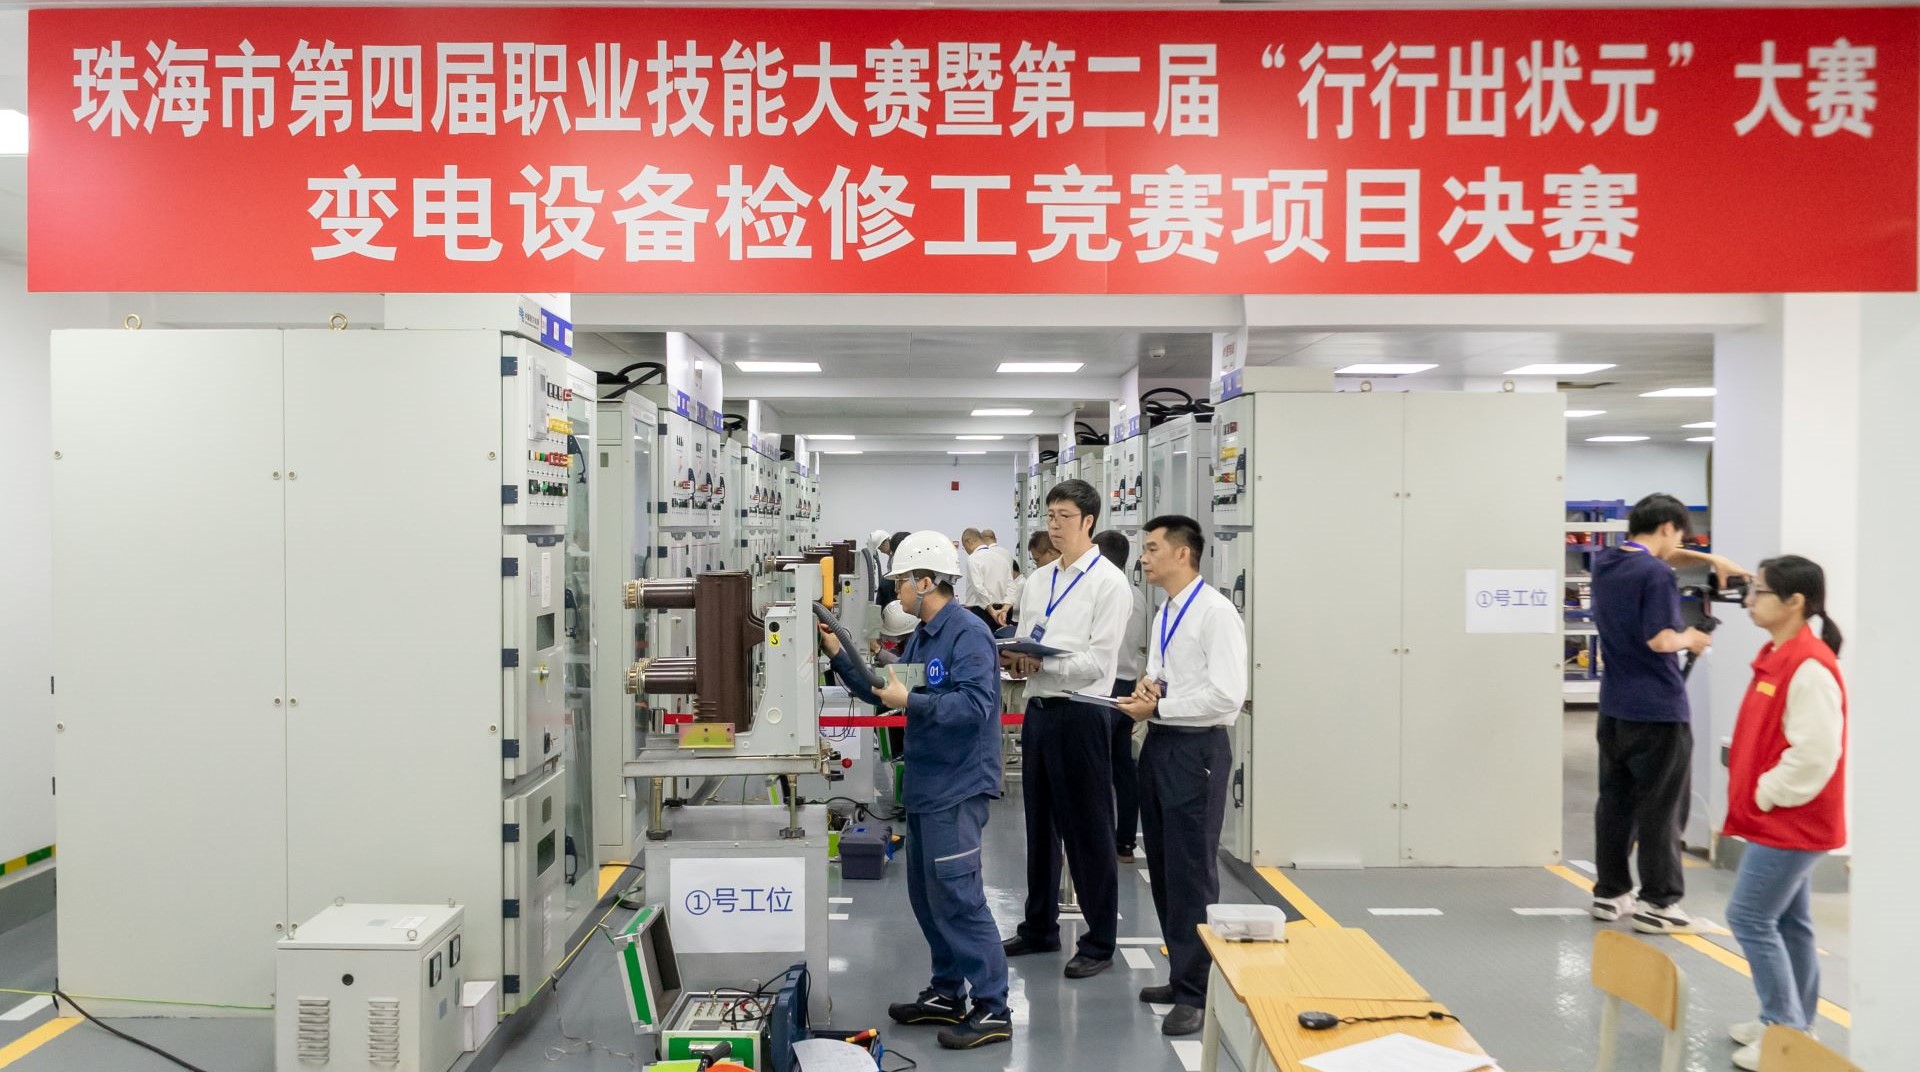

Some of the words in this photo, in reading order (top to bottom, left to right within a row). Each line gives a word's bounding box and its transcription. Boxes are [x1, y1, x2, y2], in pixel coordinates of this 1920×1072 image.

[308, 164, 1639, 264] 变电设备检修工竞赛项目决赛
[1475, 589, 1548, 608] ①号工位
[929, 665, 939, 677] 01
[685, 886, 793, 916] ①号工位
